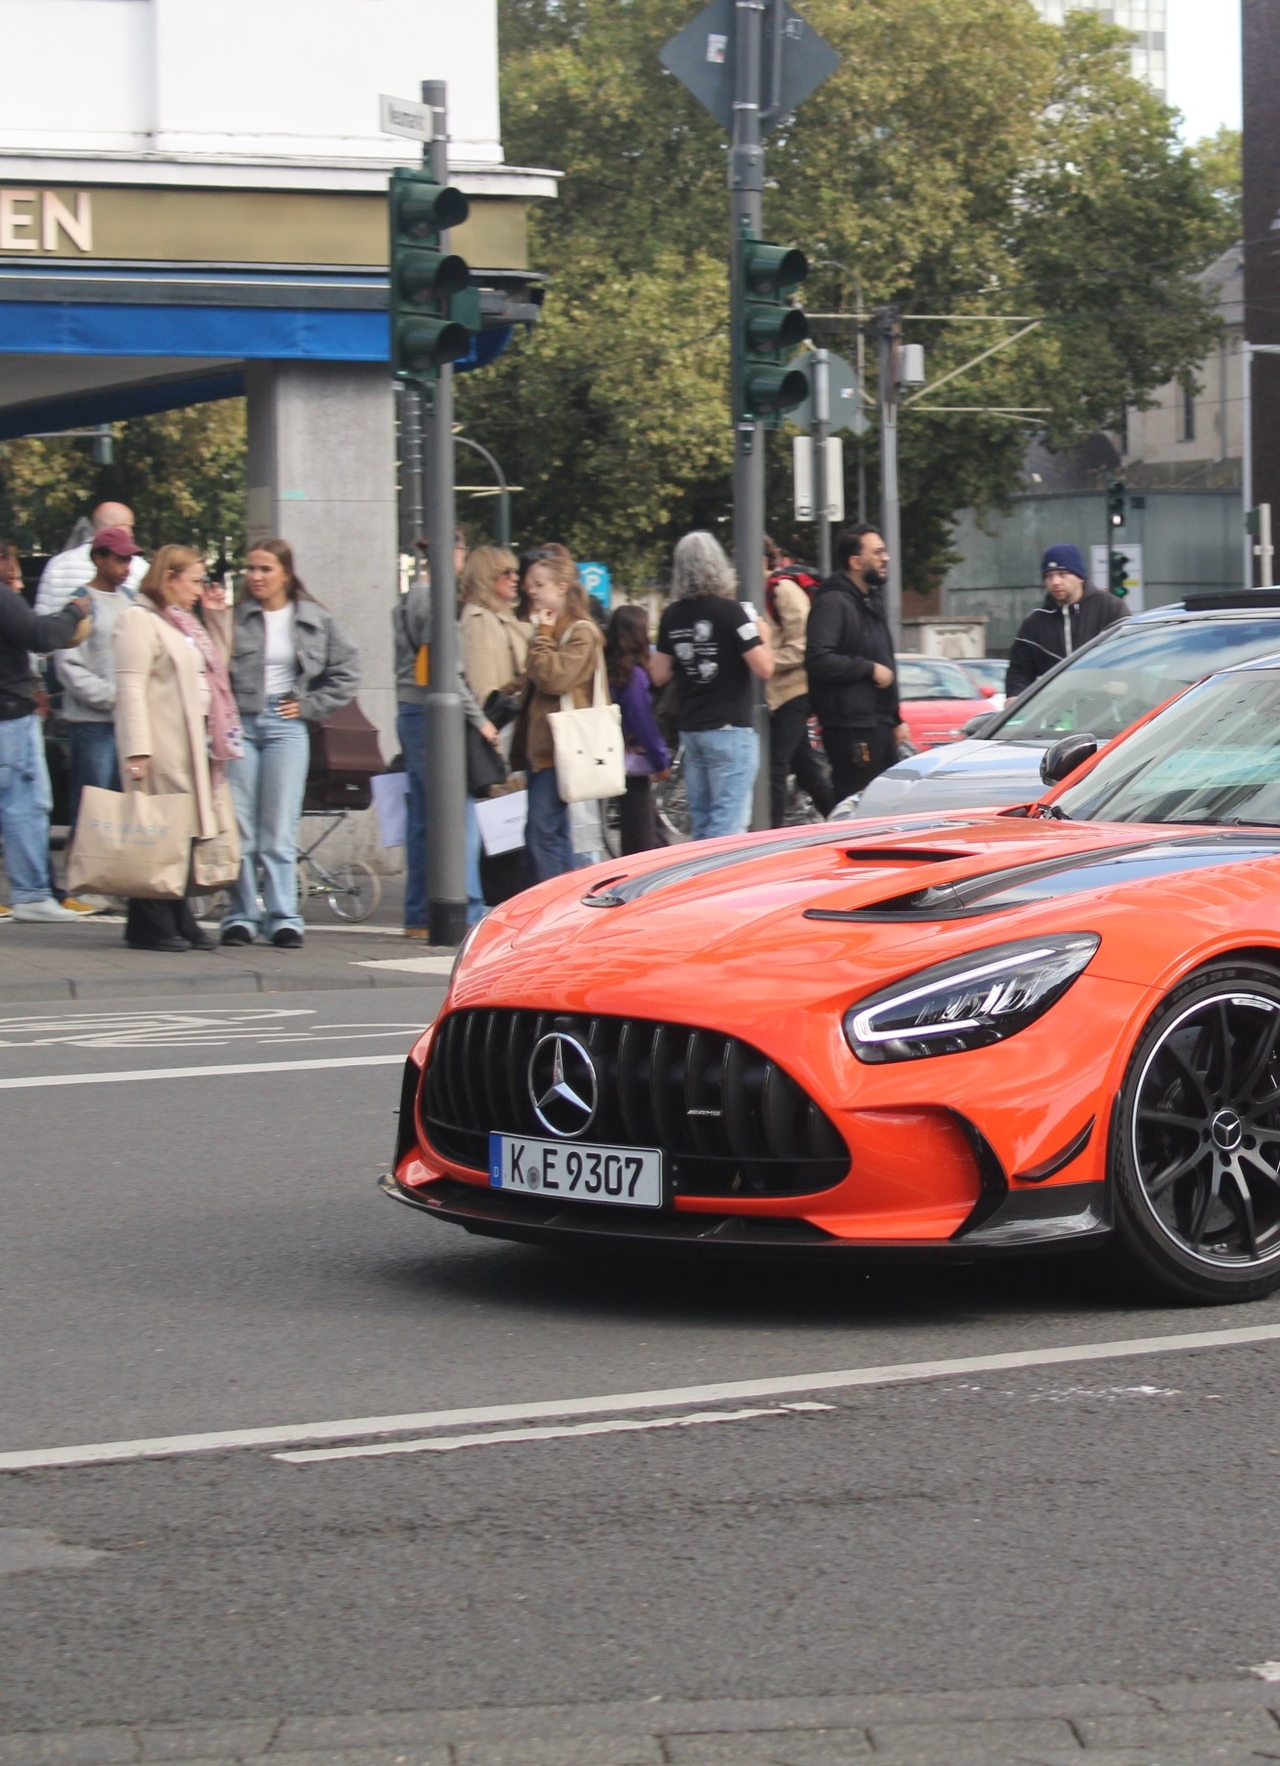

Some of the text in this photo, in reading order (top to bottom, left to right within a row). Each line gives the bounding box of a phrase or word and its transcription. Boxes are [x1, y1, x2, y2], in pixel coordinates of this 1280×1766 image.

[511, 1143, 644, 1198] K E 9307
